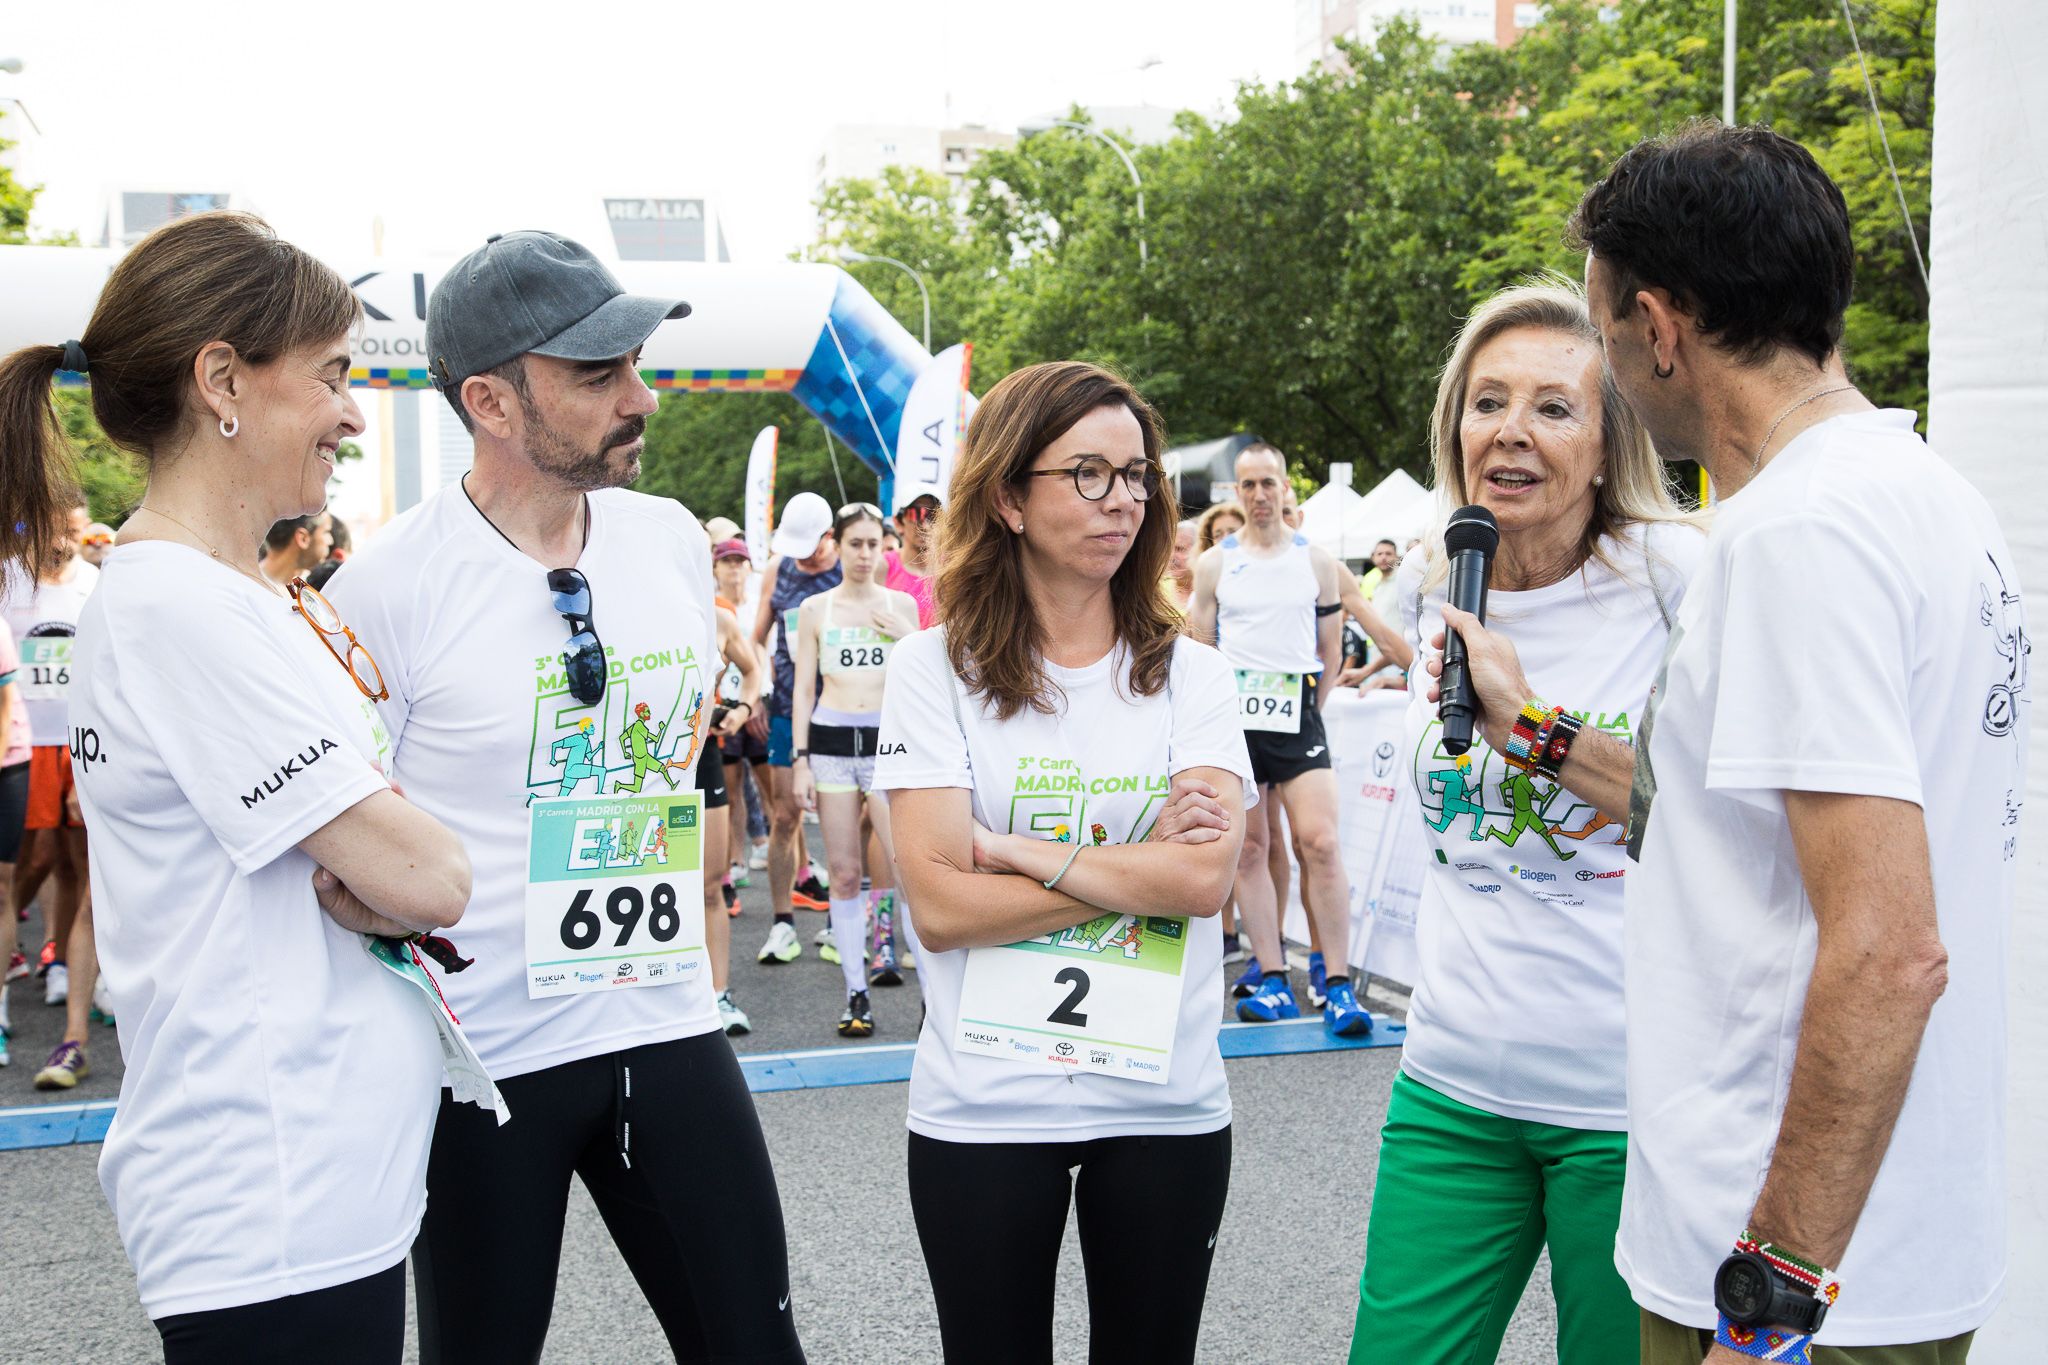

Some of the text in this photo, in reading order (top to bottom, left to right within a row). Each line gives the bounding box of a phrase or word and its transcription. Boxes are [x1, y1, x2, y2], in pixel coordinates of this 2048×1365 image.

[630, 651, 671, 674] CON
[676, 646, 696, 663] LA
[840, 648, 884, 666] 828
[1240, 697, 1293, 718] 094
[1596, 711, 1630, 730] LA
[240, 738, 339, 809] MUKUA
[1089, 775, 1139, 796] CON
[1144, 775, 1169, 792] LA
[576, 804, 623, 816] MADRID
[625, 804, 645, 814] CON
[647, 803, 660, 813] LA
[567, 815, 669, 871] ELA
[1520, 869, 1557, 882] Biogen
[560, 882, 681, 950] 698
[647, 962, 665, 970] SPORT
[649, 968, 663, 977] LIFE
[534, 974, 566, 984] MUKUA
[579, 972, 605, 983] Biogen
[1047, 966, 1091, 1027] 2
[964, 1031, 999, 1043] MUKUA
[1014, 1042, 1040, 1054] Biogen
[1089, 1049, 1111, 1059] SPORT
[1091, 1056, 1107, 1065] LIFE
[1132, 1061, 1161, 1073] MADRID
